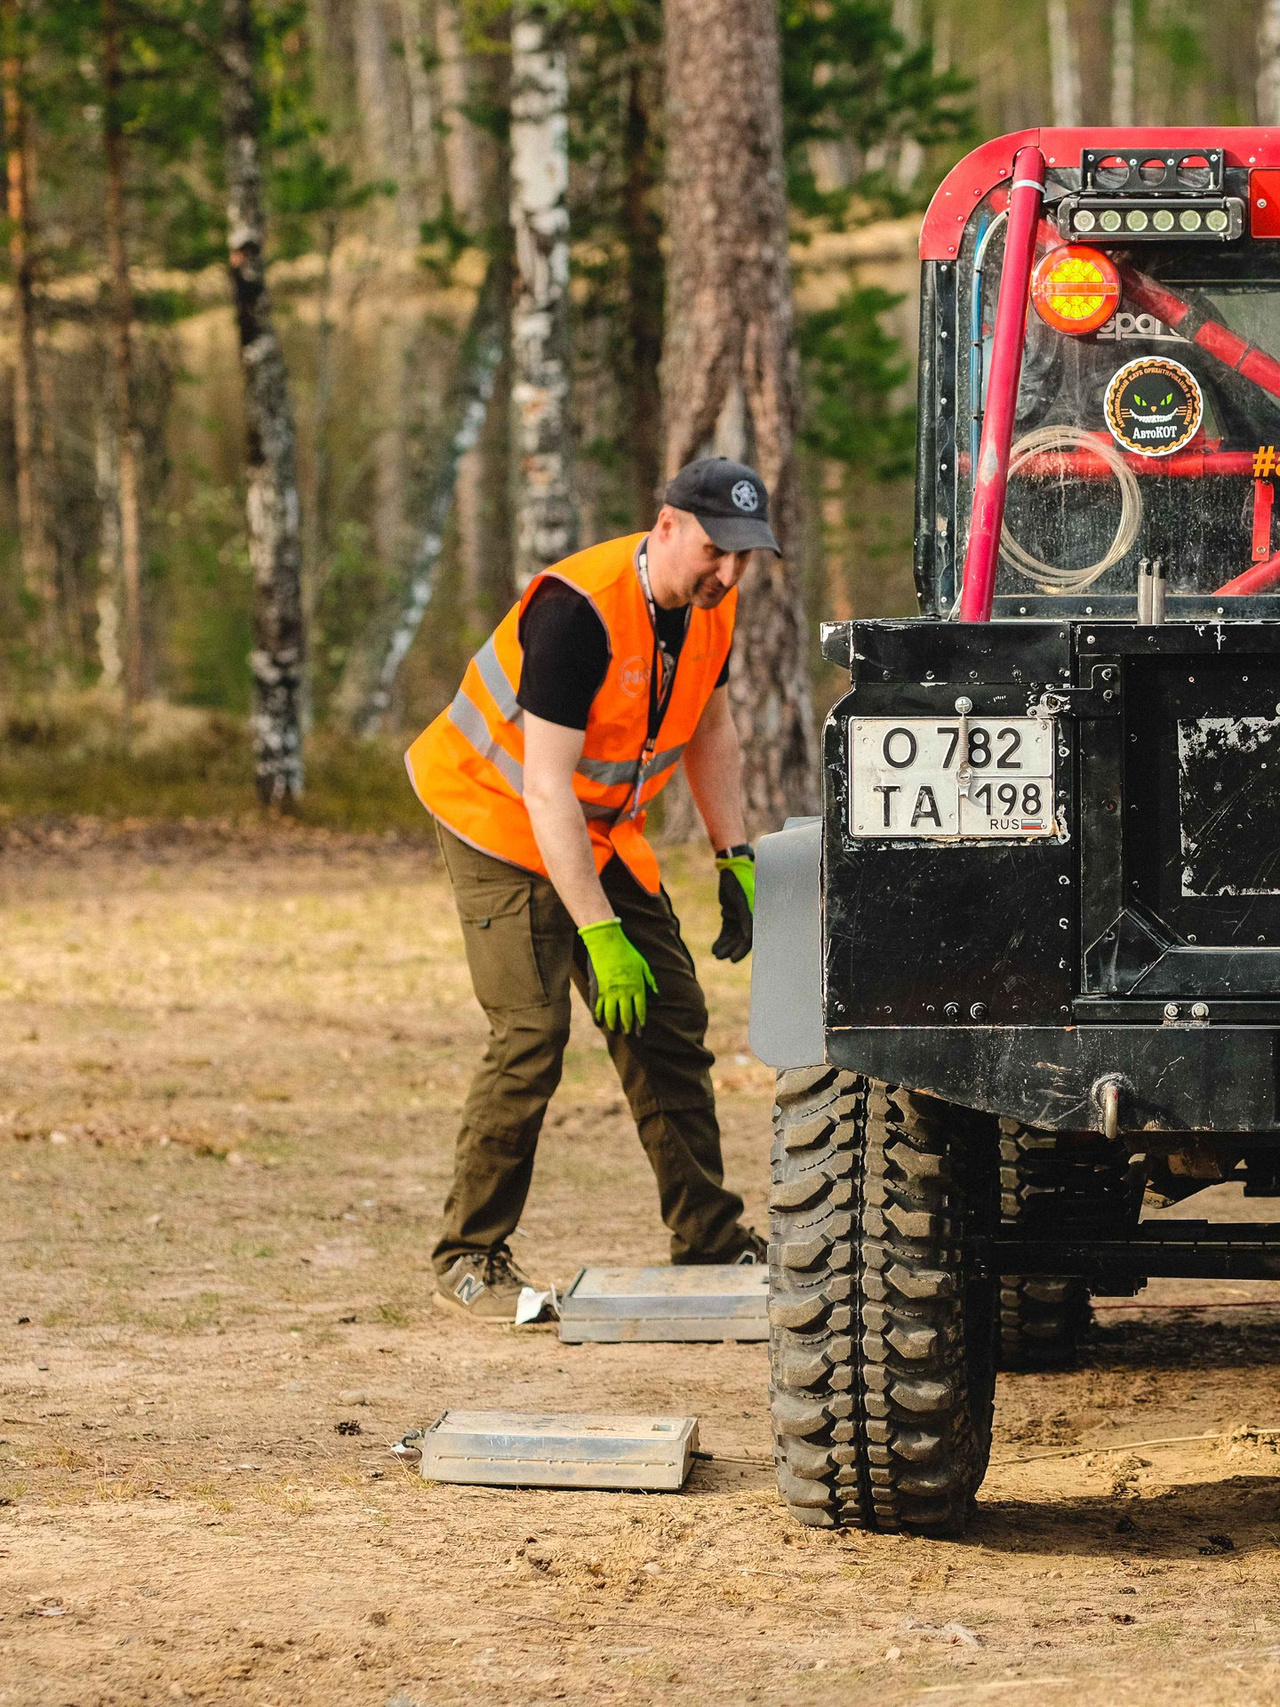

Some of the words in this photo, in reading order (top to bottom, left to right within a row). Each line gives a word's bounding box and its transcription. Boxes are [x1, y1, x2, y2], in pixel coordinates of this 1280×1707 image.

[936, 727, 1022, 769] 782
[974, 783, 1042, 816] 198
[990, 818, 1020, 830] RUS
